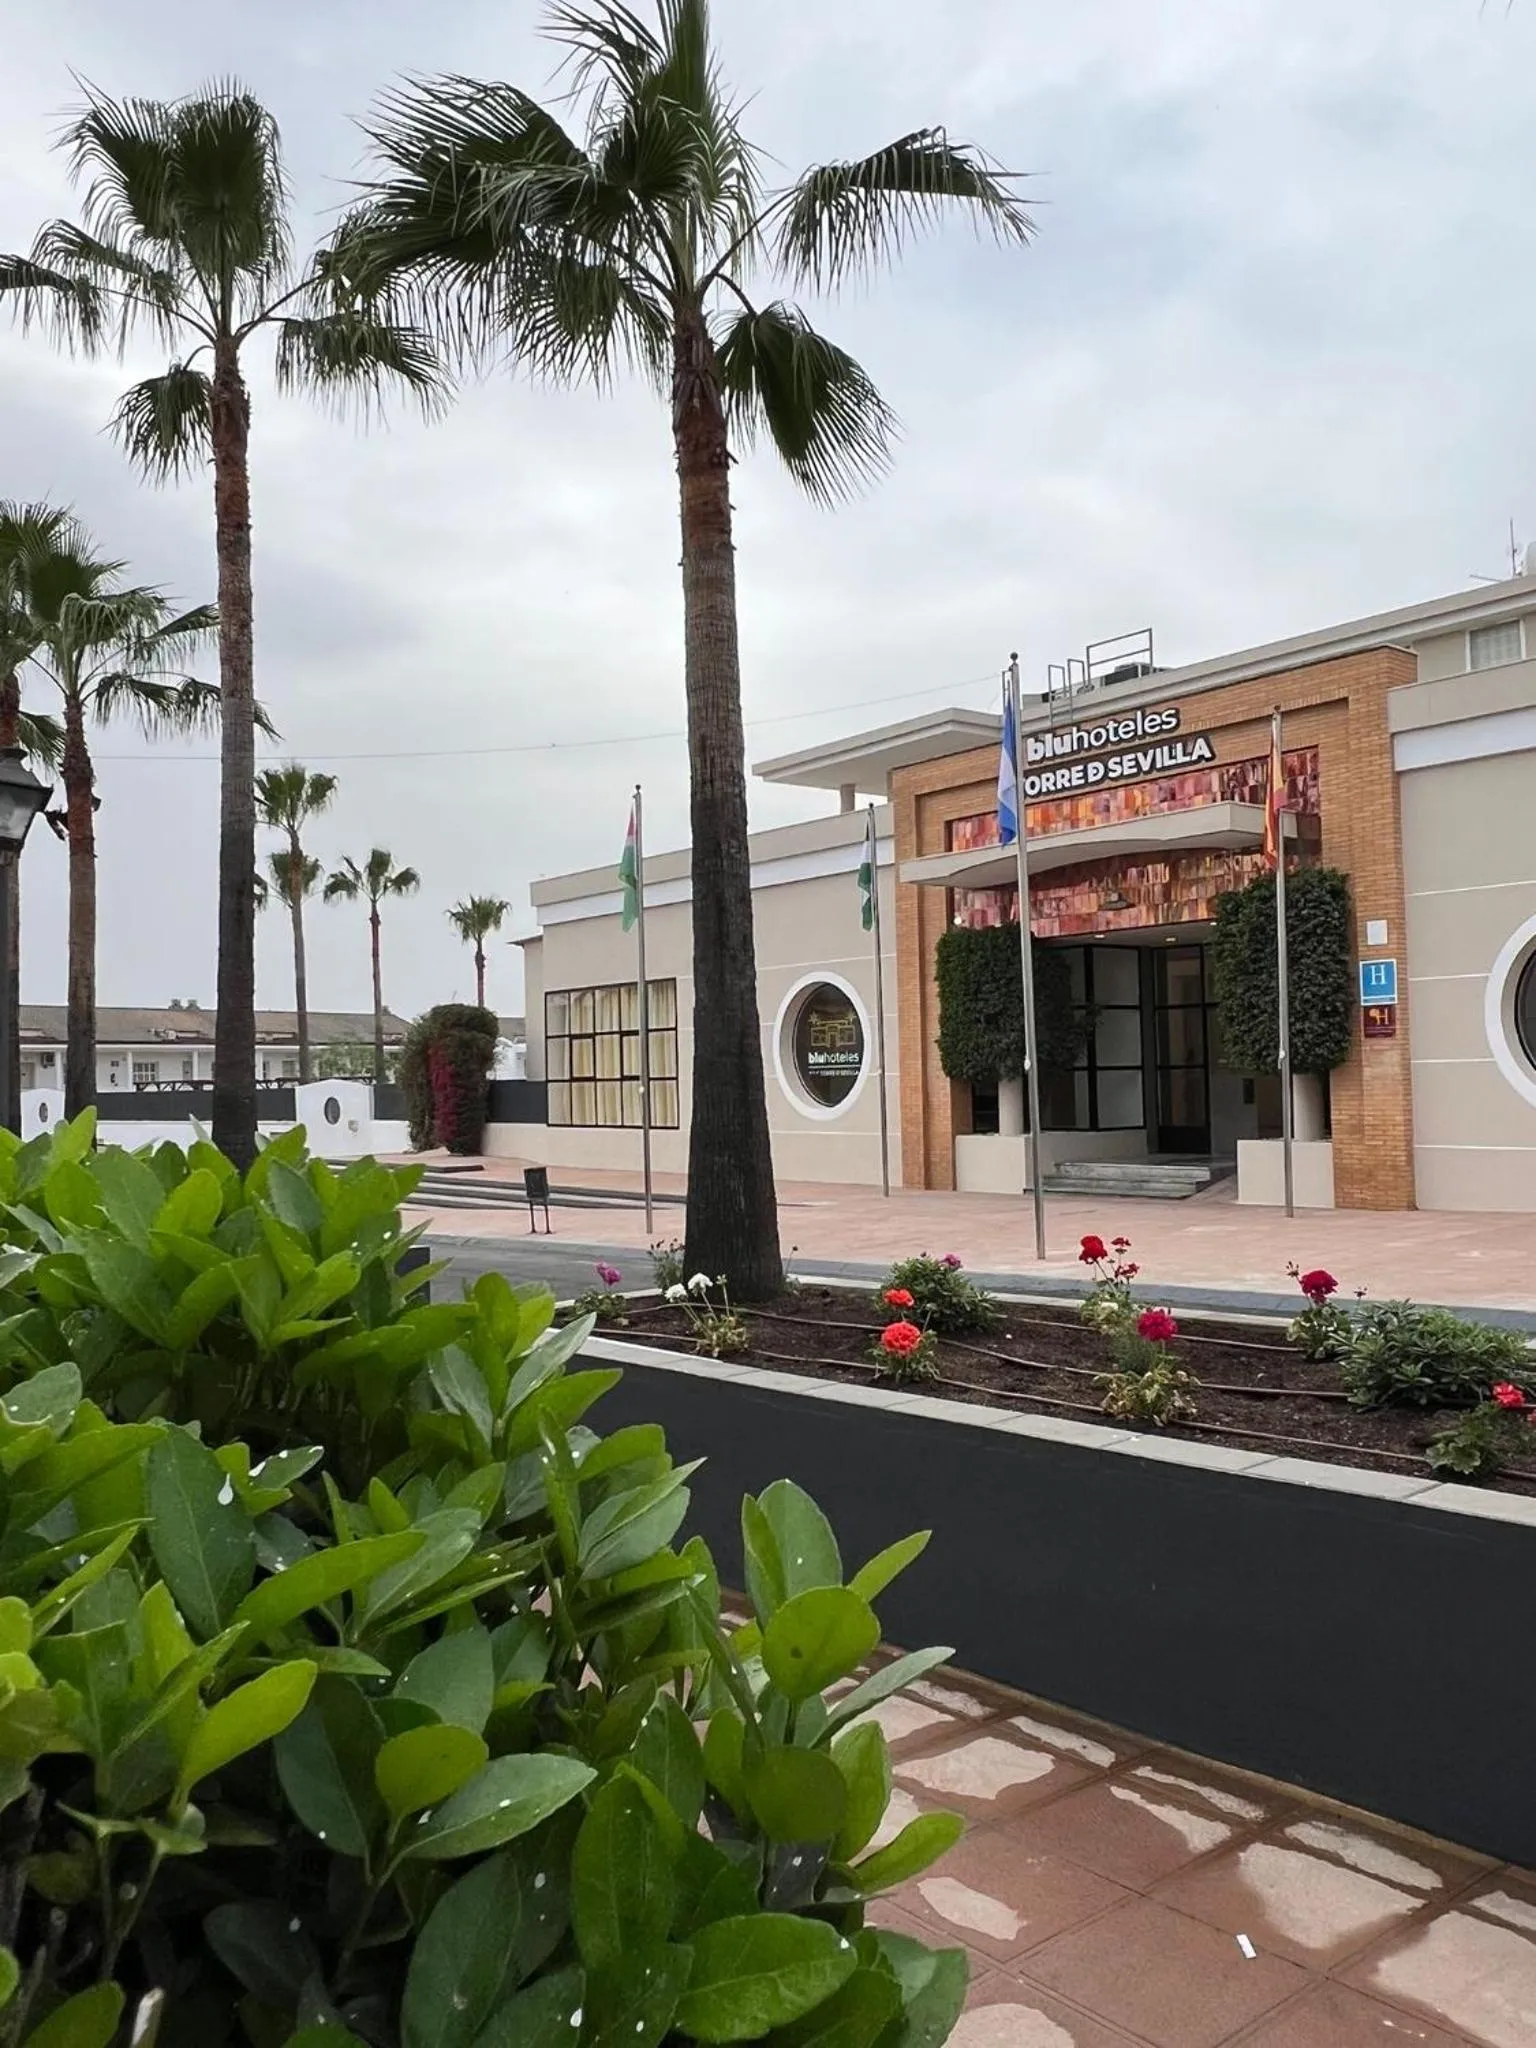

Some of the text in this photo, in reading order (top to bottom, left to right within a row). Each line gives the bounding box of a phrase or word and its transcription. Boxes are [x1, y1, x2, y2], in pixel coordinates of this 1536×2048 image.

[1027, 709, 1178, 762] bluhoteles
[1023, 764, 1085, 796] ORRE
[1108, 738, 1212, 778] SEVILLA
[1369, 964, 1388, 985] H
[808, 1051, 859, 1064] bluhoteles
